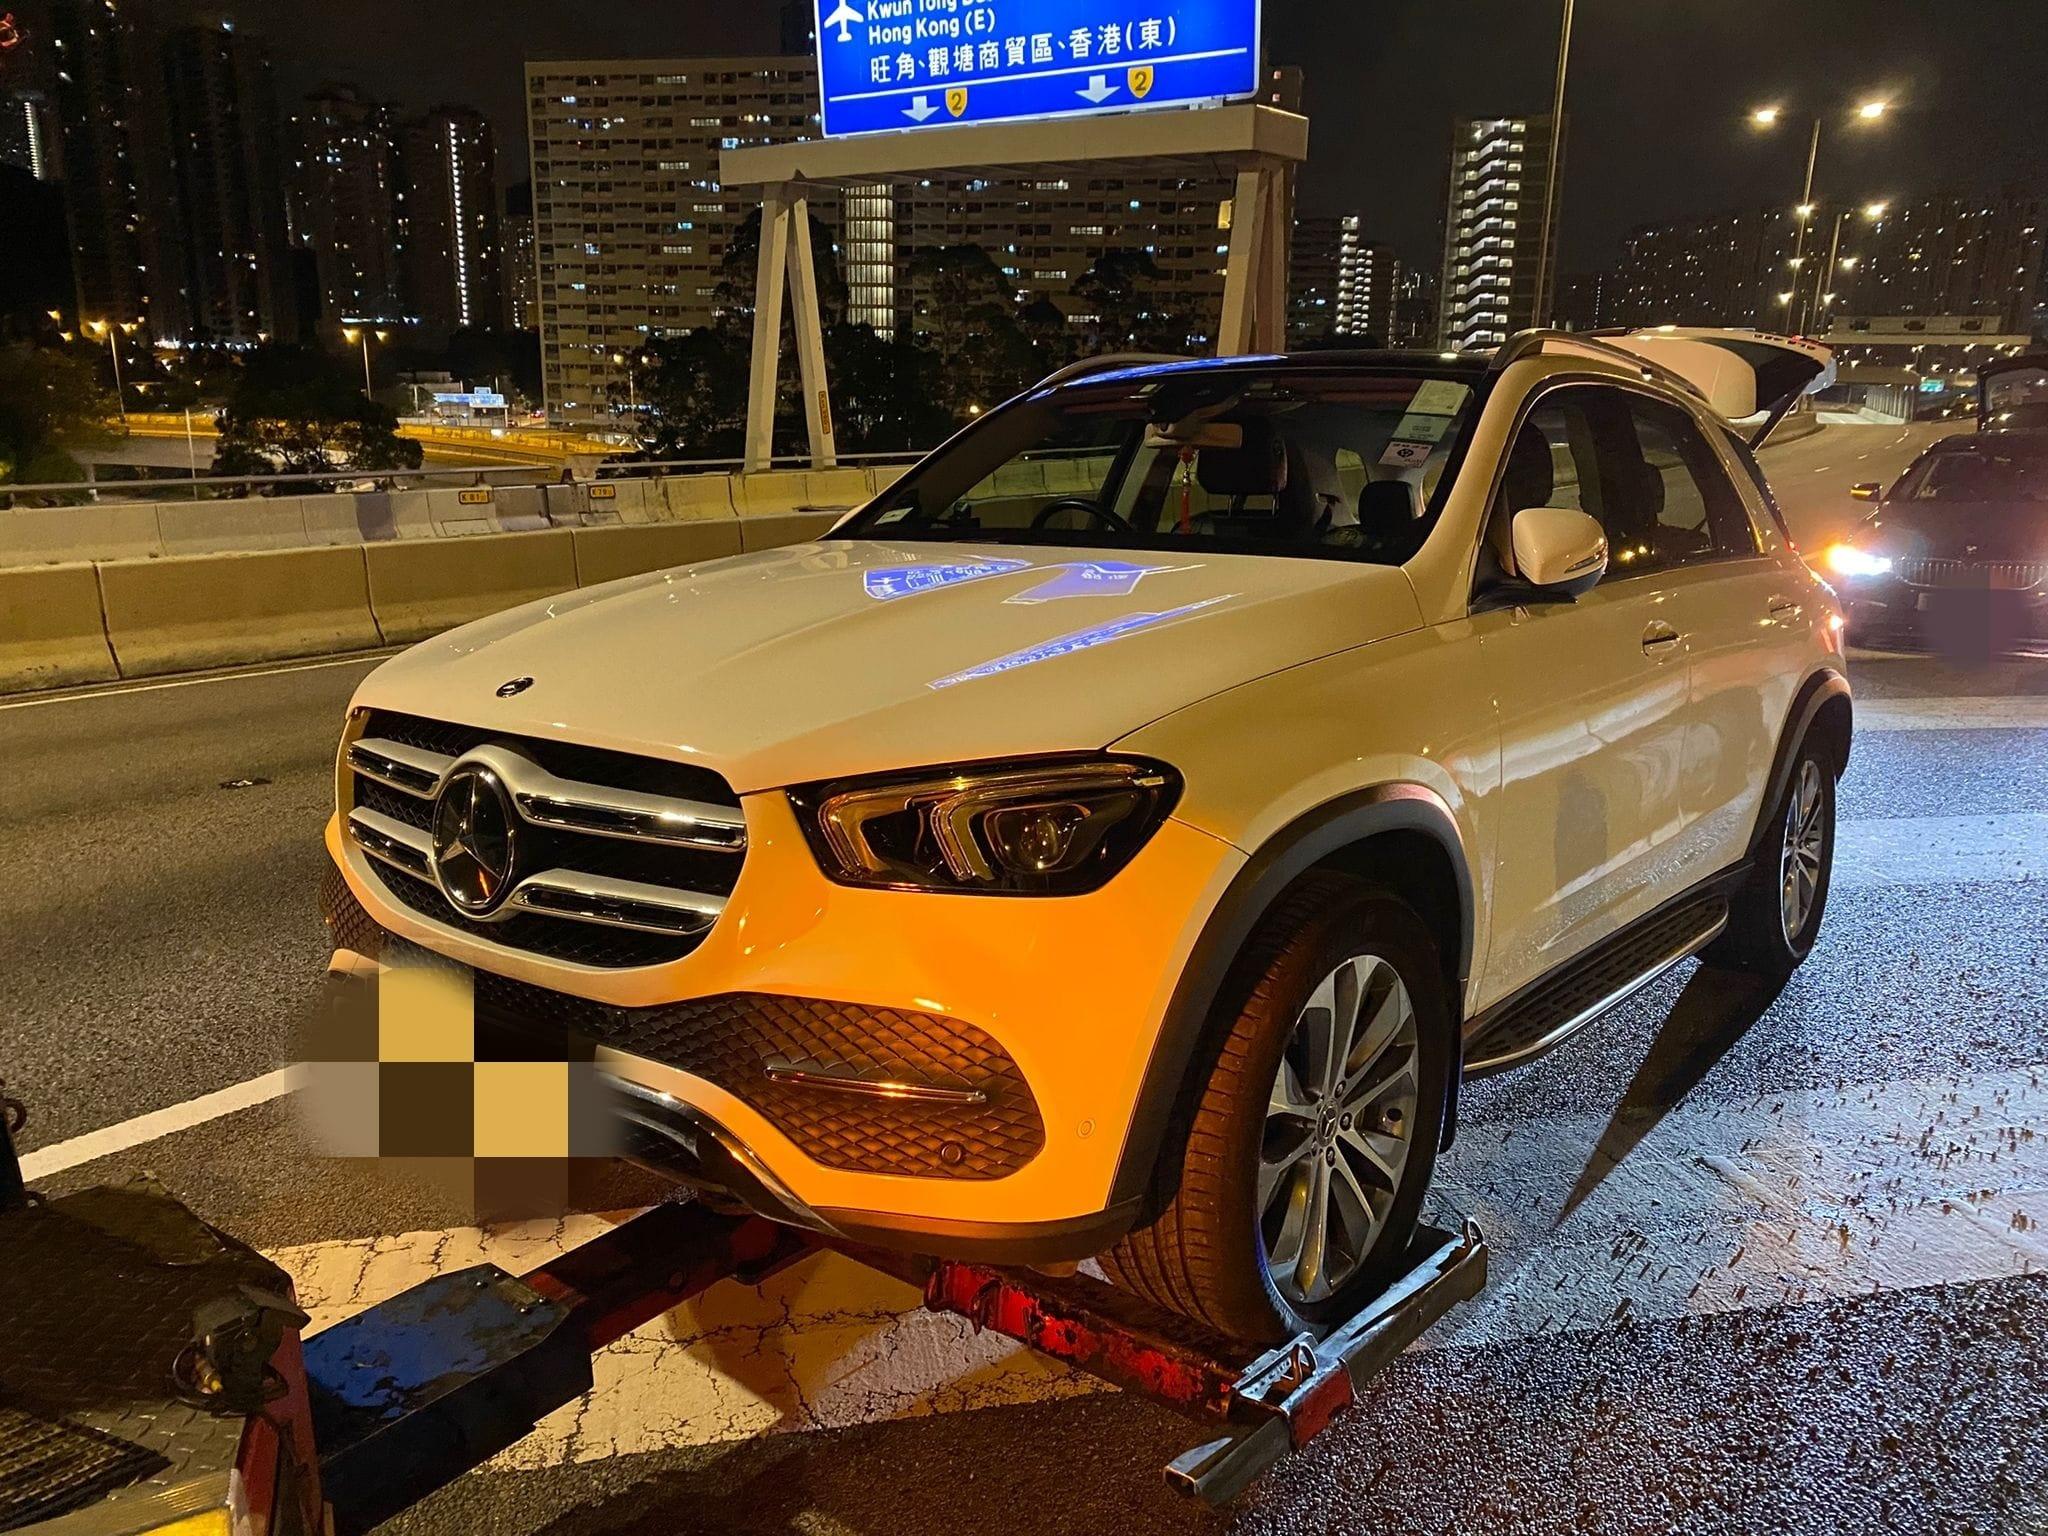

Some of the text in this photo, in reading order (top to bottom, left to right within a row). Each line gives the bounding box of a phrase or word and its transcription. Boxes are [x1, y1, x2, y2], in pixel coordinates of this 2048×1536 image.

[867, 0, 912, 20] Kwun
[868, 8, 996, 45] Hong Kong (E)
[1134, 71, 1147, 91] 2
[951, 92, 962, 111] 2
